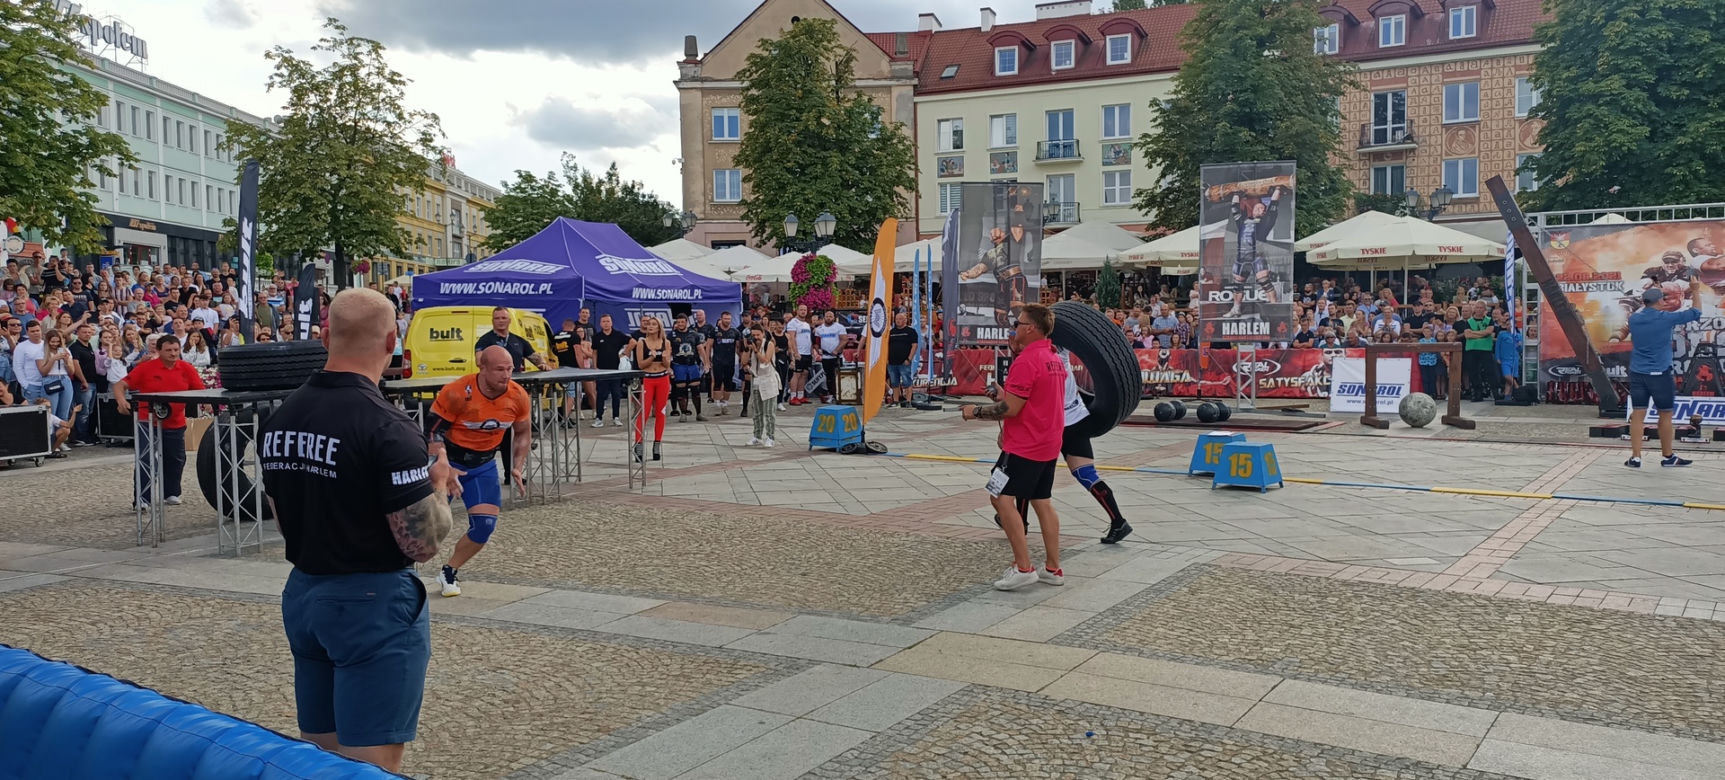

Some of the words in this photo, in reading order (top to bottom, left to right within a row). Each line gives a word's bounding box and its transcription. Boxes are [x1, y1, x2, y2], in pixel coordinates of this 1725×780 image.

[1360, 247, 1387, 256] TYSKIE
[1438, 245, 1464, 254] TYSKIE
[468, 260, 567, 274] SONAROL
[599, 256, 680, 275] SONAROL
[440, 281, 554, 295] WWW.SONAROL.PL
[632, 287, 703, 300] WWW.SONAROL.PL
[1208, 288, 1270, 302] ROUE
[429, 327, 464, 341] bult
[976, 327, 1010, 340] HARLE
[1222, 321, 1271, 335] HARLEM
[1606, 365, 1628, 377] ult
[1259, 374, 1331, 389] SATYSFAKC
[1337, 383, 1402, 397] SONROL
[817, 413, 836, 434] 20
[842, 411, 859, 433] 20
[262, 430, 341, 466] REFEREE
[1228, 453, 1253, 478] 15
